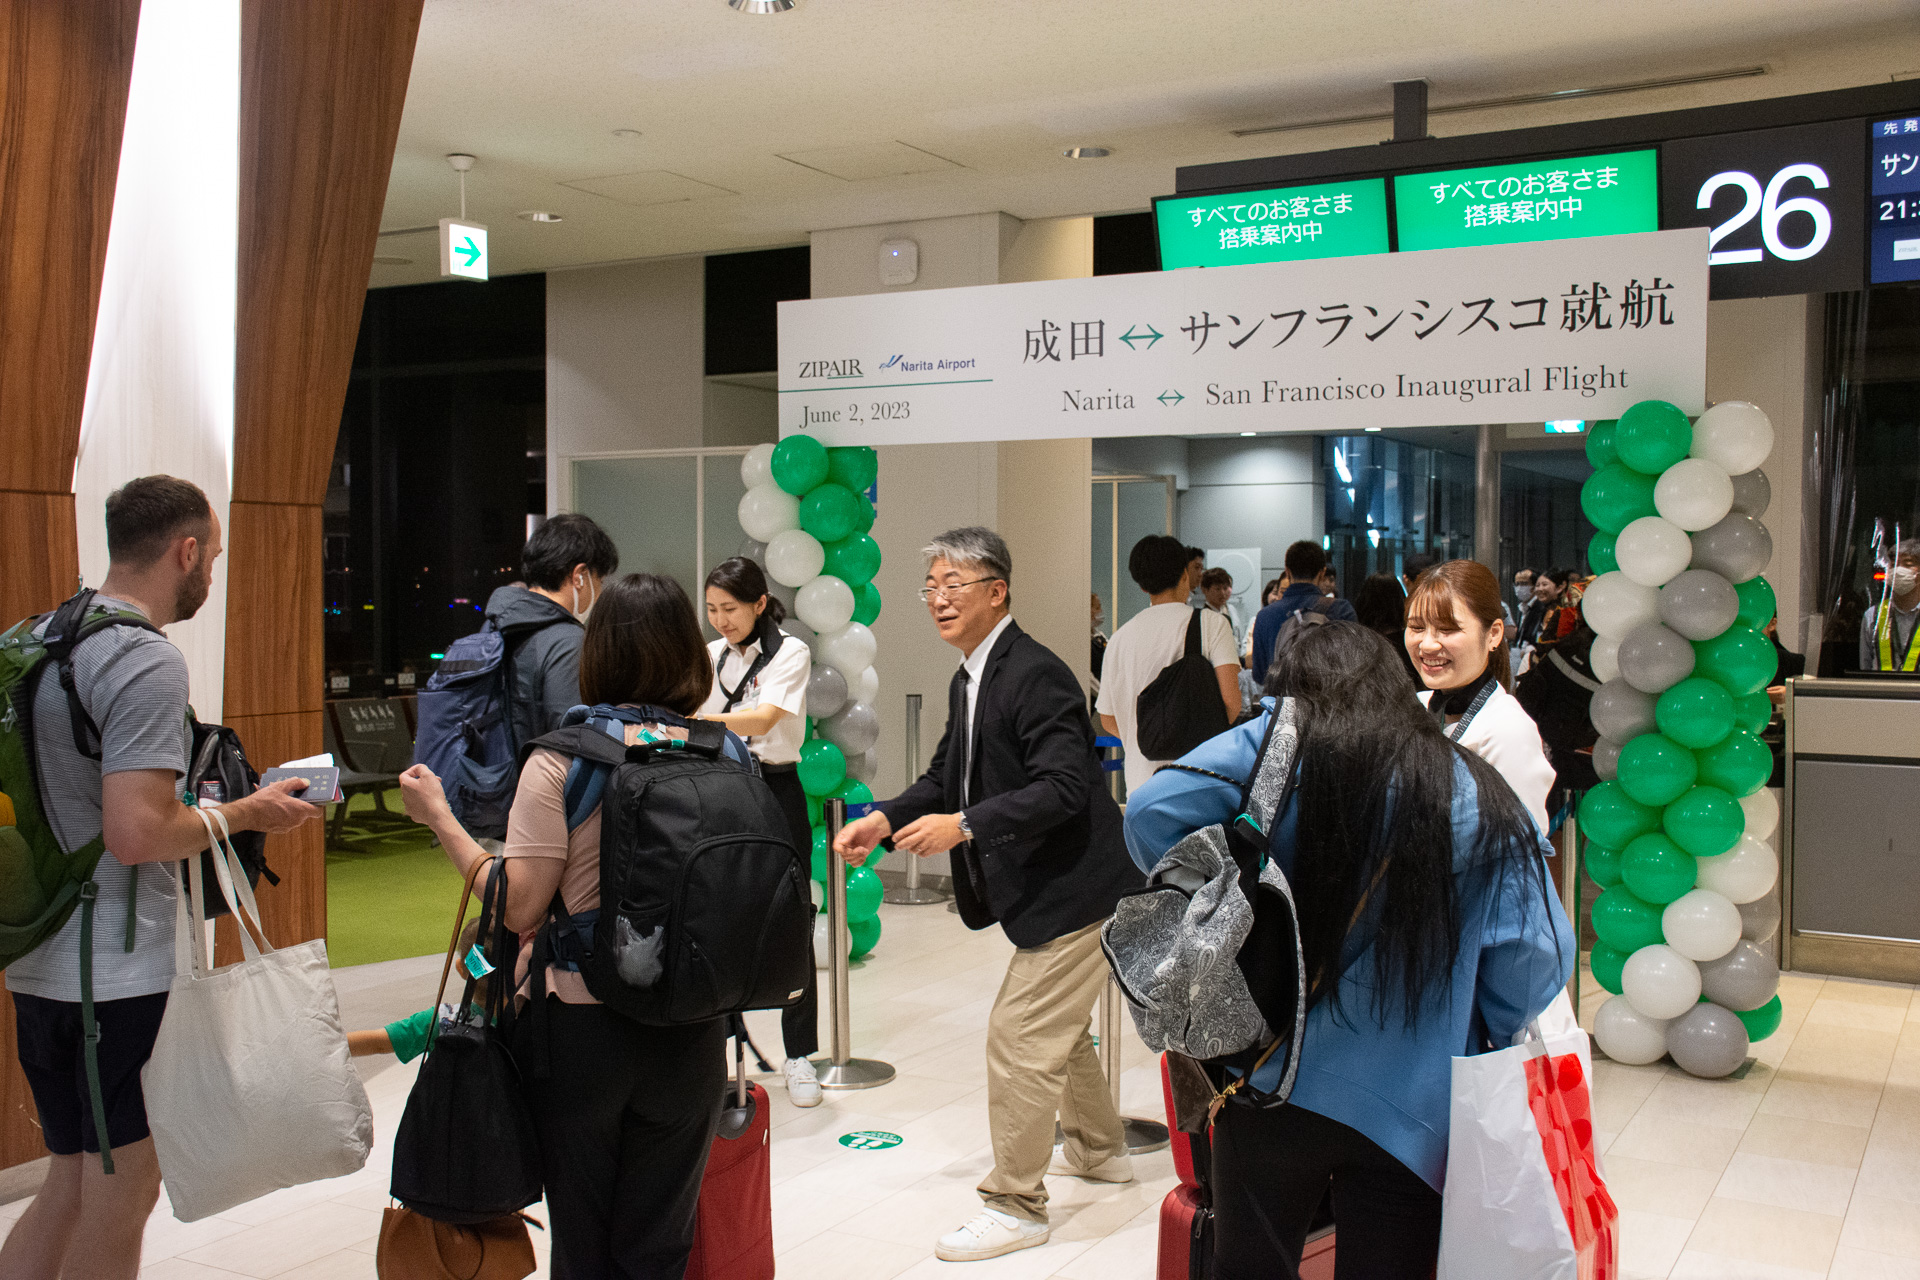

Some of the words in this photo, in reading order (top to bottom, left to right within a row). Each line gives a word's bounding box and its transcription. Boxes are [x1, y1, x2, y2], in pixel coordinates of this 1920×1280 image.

[1429, 166, 1619, 204] すべてのお客さま
[1187, 193, 1353, 228] すべてのお客さま
[1464, 196, 1583, 228] 搭乗案内中
[1696, 162, 1832, 266] 26
[1880, 200, 1920, 221] 21:
[1219, 220, 1323, 250] 搭乗案内中
[1023, 319, 1105, 364] 成田
[1180, 277, 1675, 356] サンフランシスコ就航
[799, 359, 864, 379] ZIPAIR
[901, 361, 934, 372] Narita
[937, 358, 976, 372] Airport
[1061, 388, 1136, 412] Narita
[1206, 383, 1252, 406] San
[1261, 377, 1386, 403] Francisco
[1395, 367, 1532, 403] Inaugural
[1542, 364, 1629, 398] Flight
[799, 405, 842, 429] June
[849, 403, 865, 426] 2,
[871, 401, 911, 421] 2023
